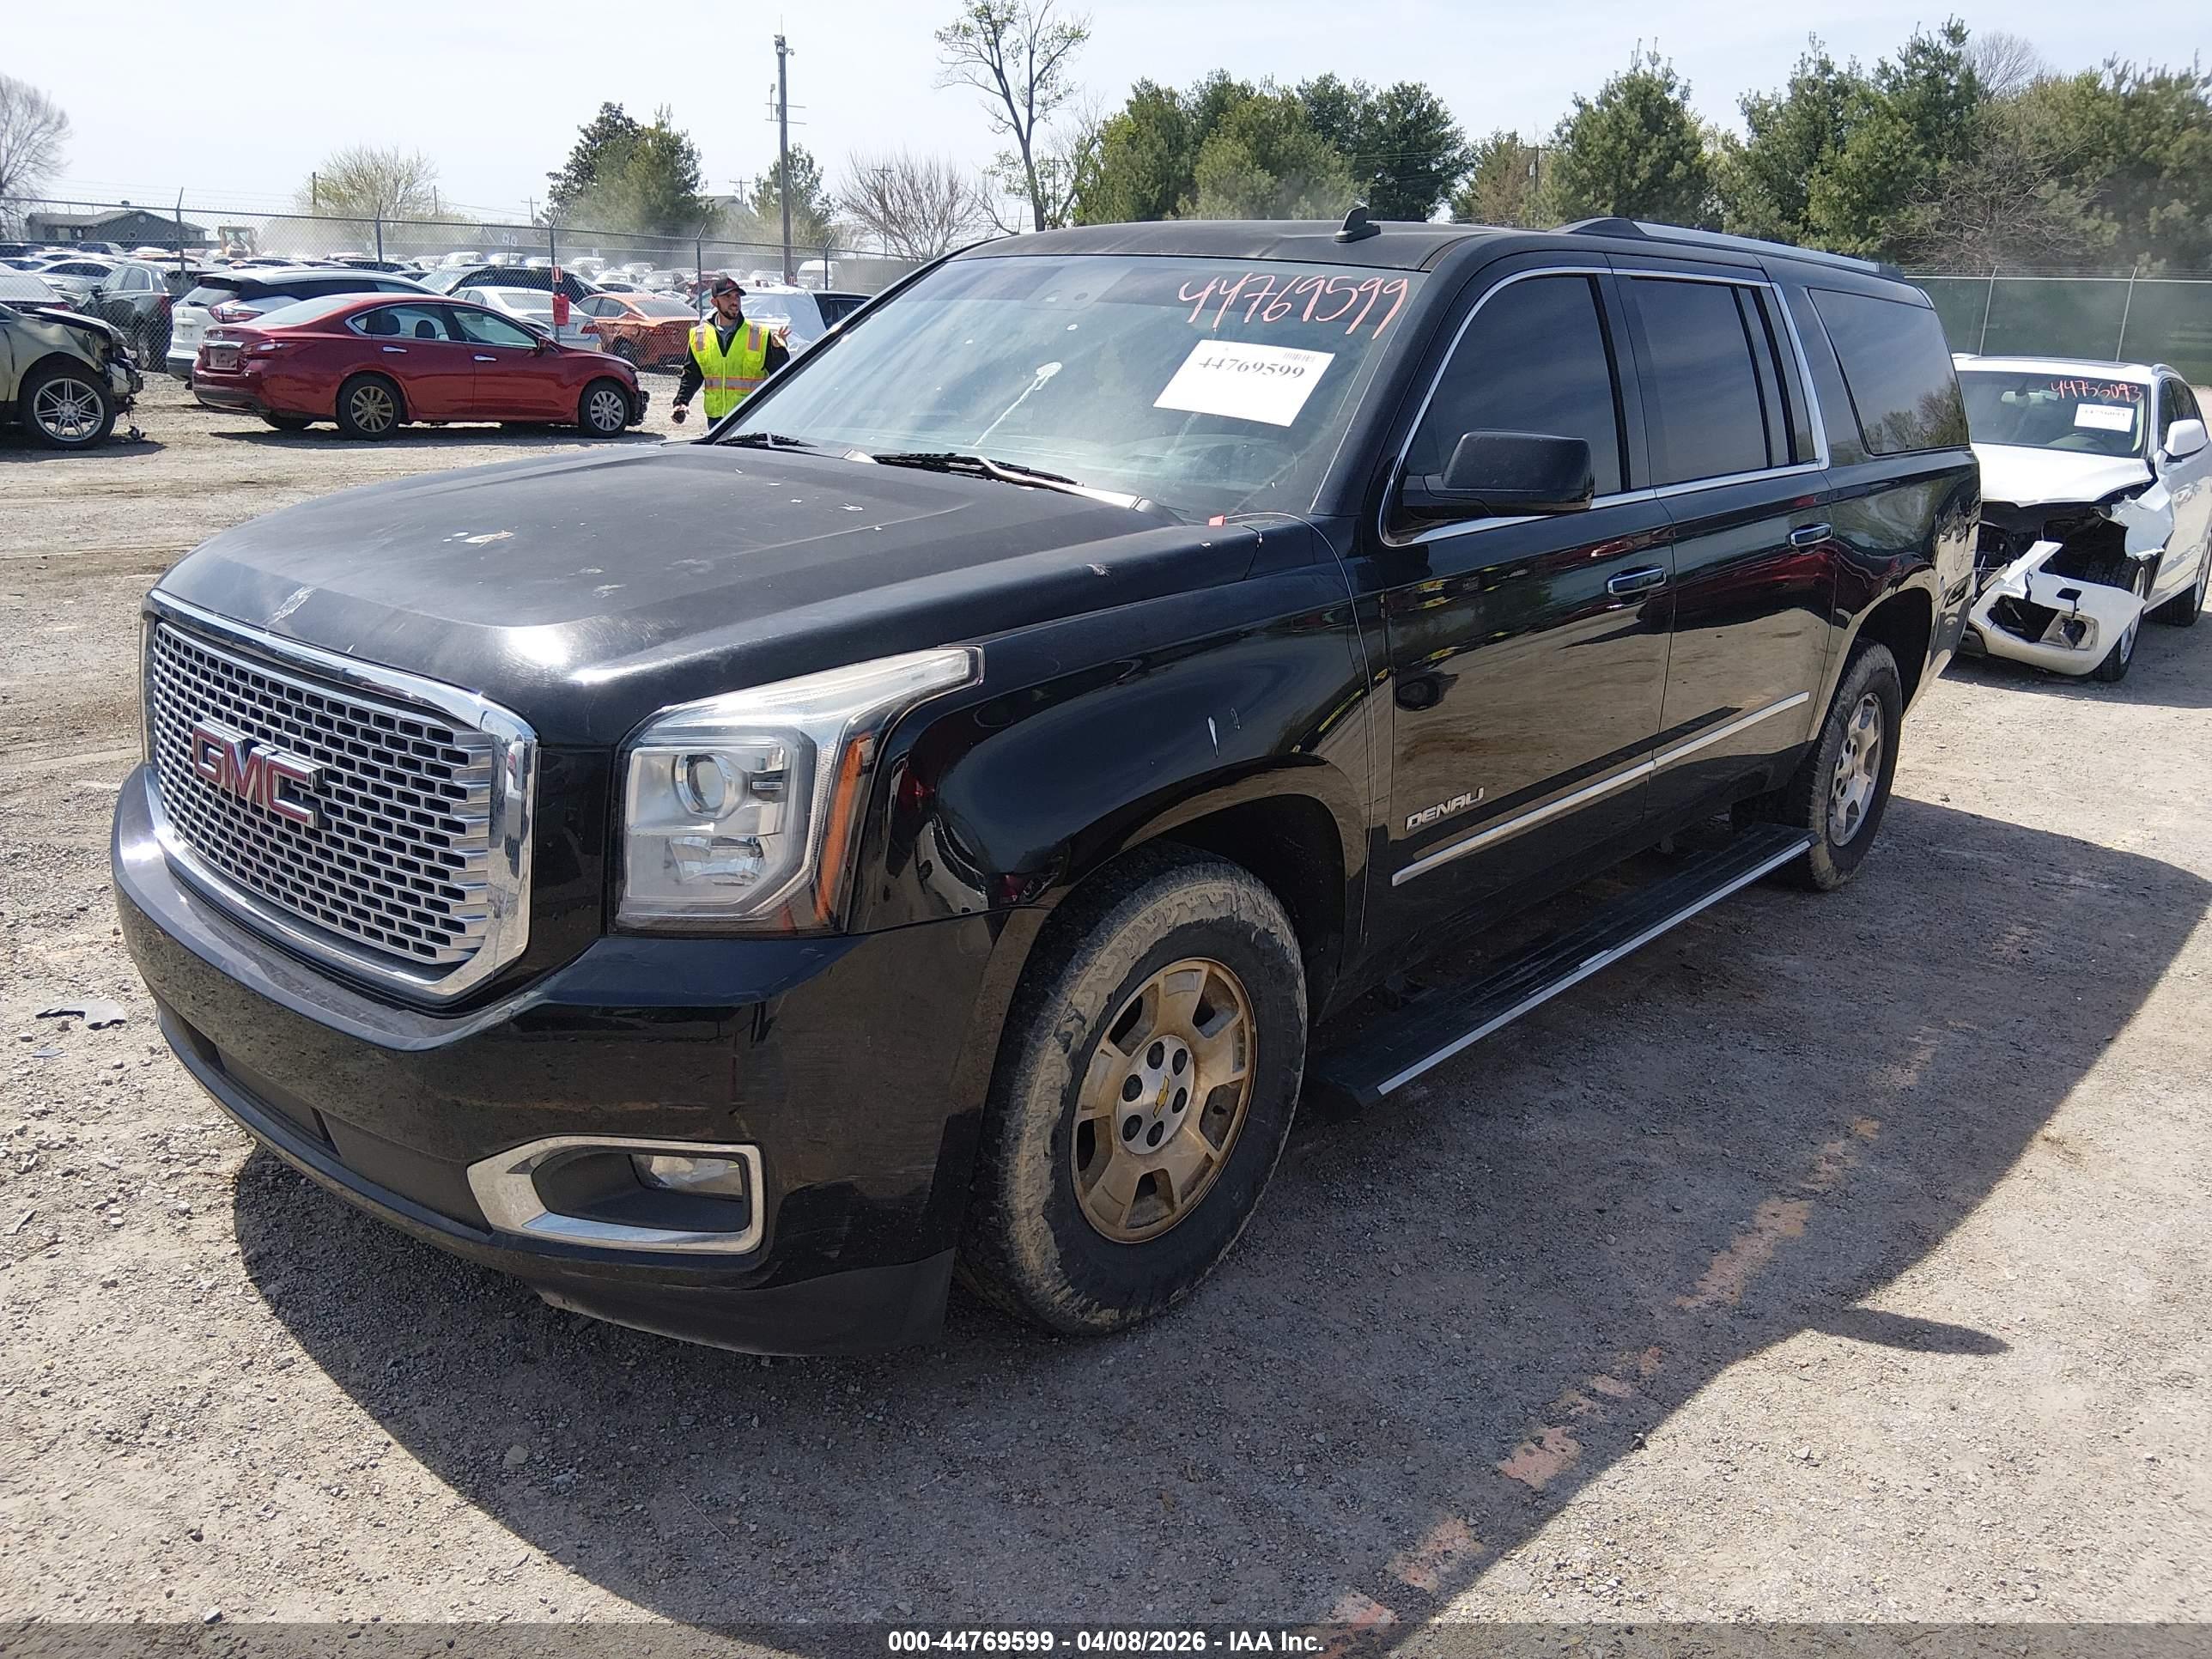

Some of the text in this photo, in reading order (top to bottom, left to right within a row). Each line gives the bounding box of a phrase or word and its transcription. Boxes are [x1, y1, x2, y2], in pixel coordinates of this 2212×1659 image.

[1177, 272, 1408, 340] 44769599
[1199, 356, 1306, 379] 44769599
[191, 726, 320, 830] GMC
[1405, 786, 1486, 832] DENALI
